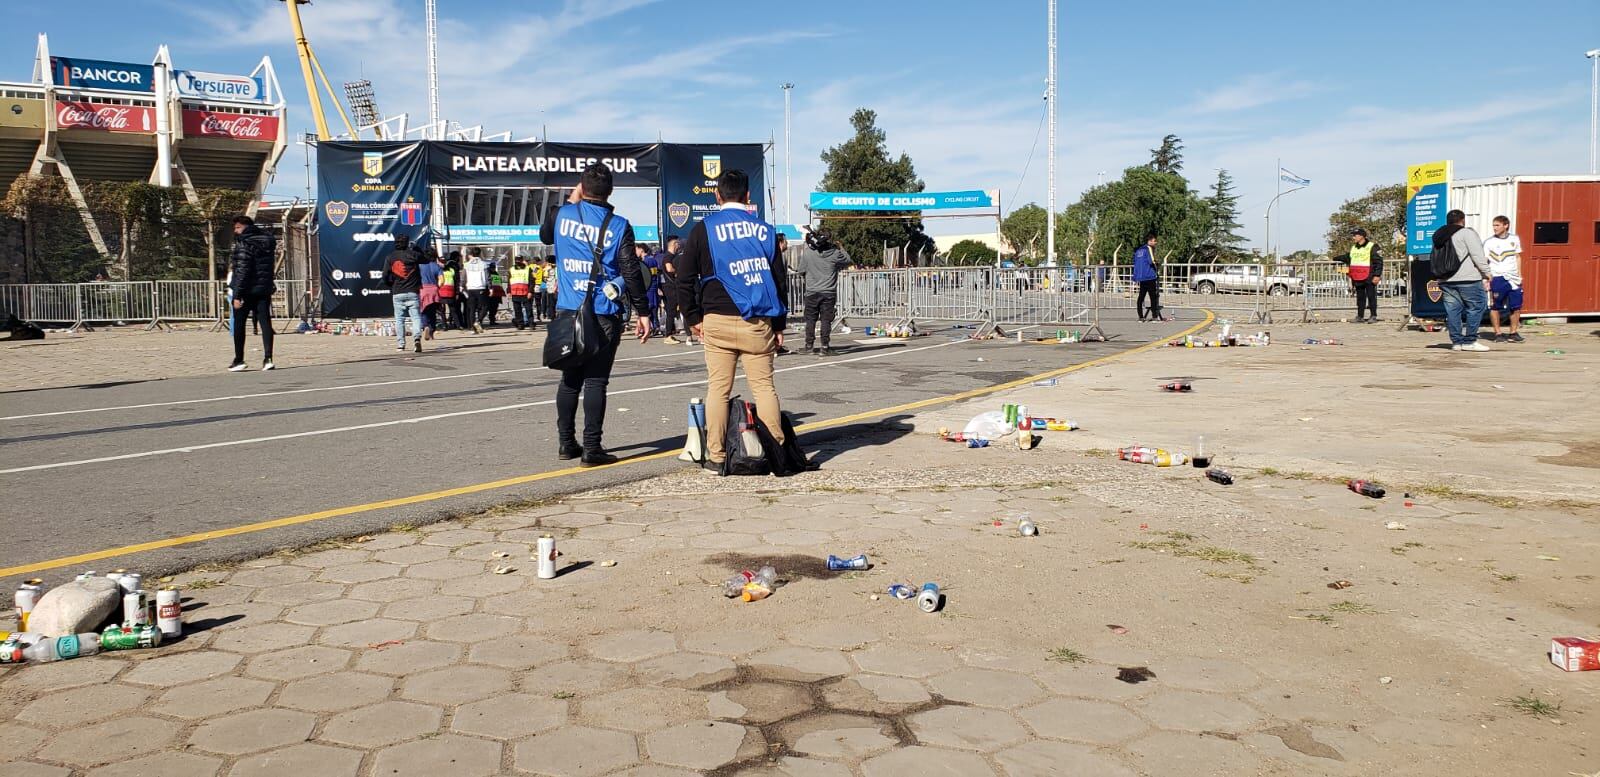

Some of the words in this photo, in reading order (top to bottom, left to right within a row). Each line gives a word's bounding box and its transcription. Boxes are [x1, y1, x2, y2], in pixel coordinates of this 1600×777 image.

[71, 66, 141, 84] BANCOR
[187, 75, 250, 96] Tersuave
[58, 105, 128, 128] Coca-Cola
[201, 115, 262, 137] Coca-Cola
[452, 156, 523, 172] PLATEA
[523, 157, 598, 173] ARDILES
[601, 157, 638, 173] SUR
[832, 196, 875, 206] CIRCUITO
[877, 197, 890, 206] DE
[893, 197, 935, 206] CICLISMO
[715, 220, 768, 242] UTEDYC
[344, 271, 361, 279] BNA
[563, 258, 594, 275] CONT
[573, 279, 590, 292] 345
[744, 273, 763, 286] 3441
